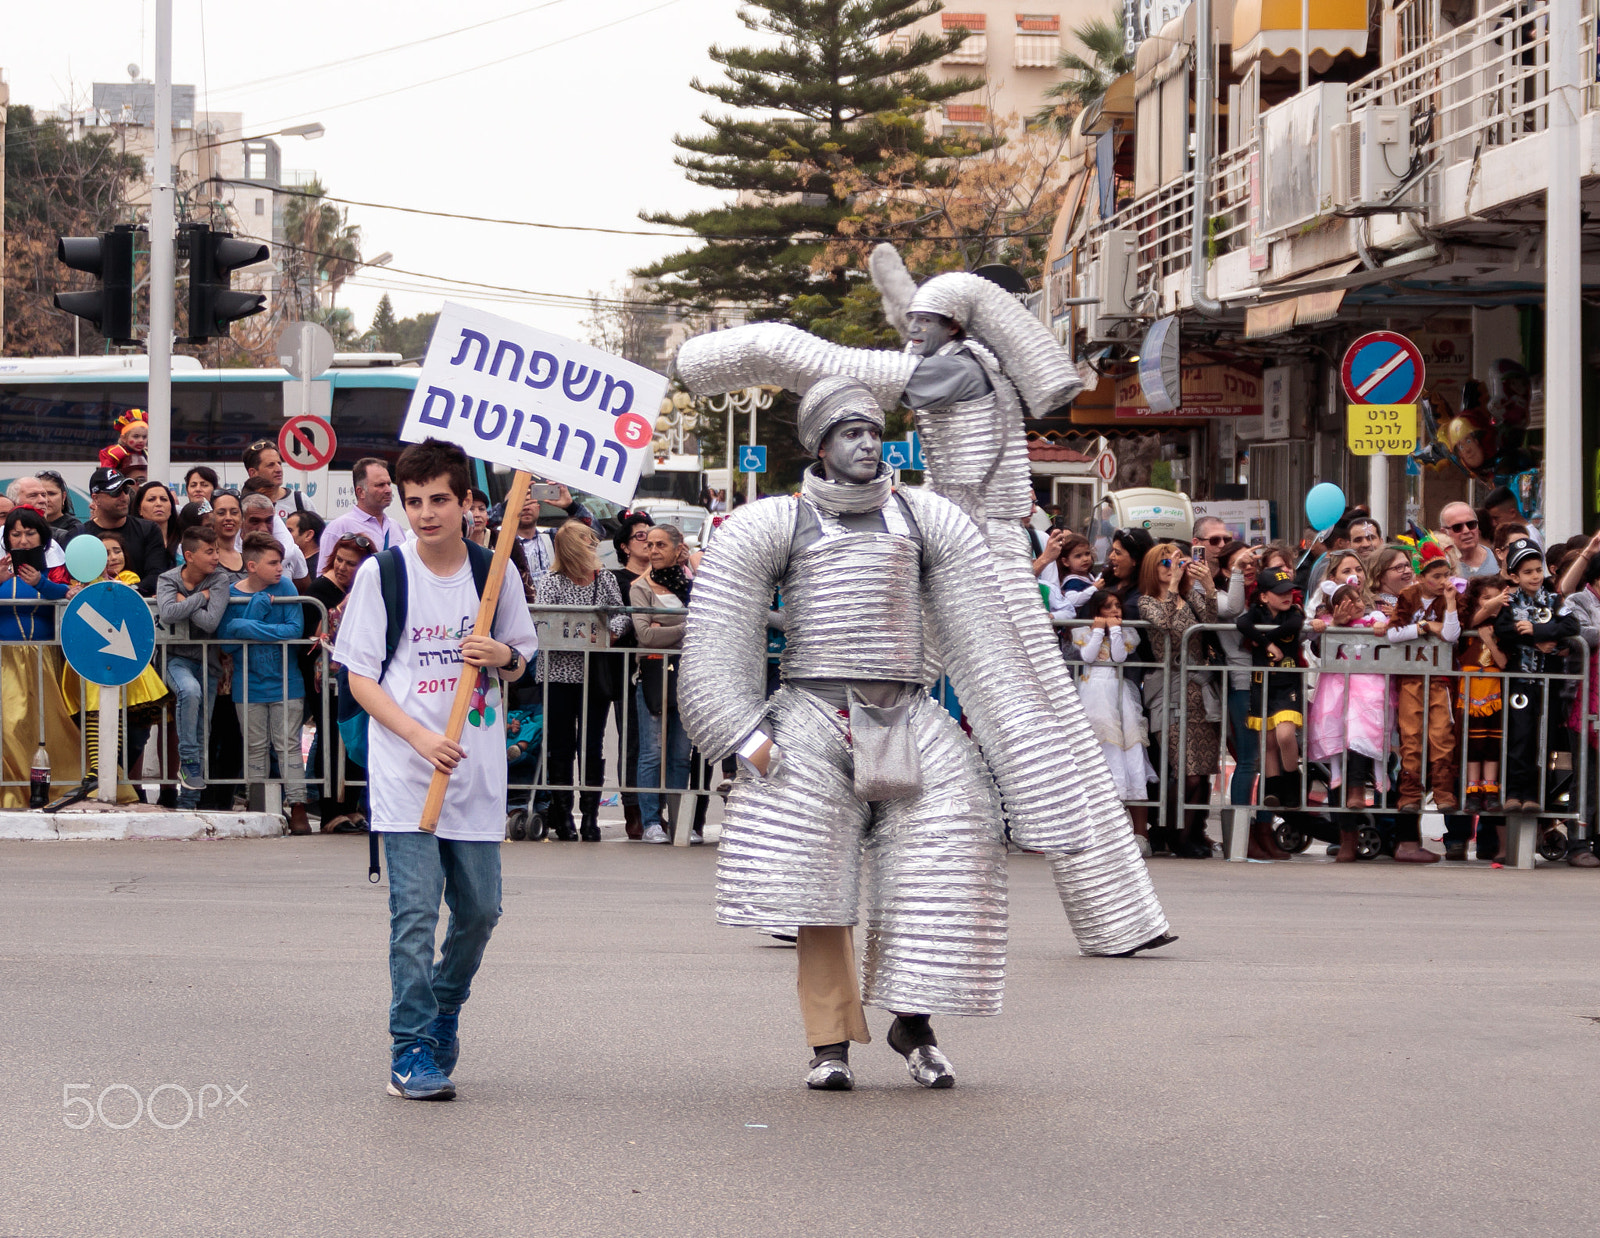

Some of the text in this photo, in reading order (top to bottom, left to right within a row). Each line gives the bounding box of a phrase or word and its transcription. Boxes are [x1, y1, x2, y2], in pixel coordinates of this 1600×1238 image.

[450, 327, 635, 417] משפחת
[1368, 410, 1399, 421] פרט
[418, 385, 628, 484] הרובוטים
[625, 421, 642, 440] 5
[1365, 422, 1402, 434] לרכב
[1354, 439, 1413, 449] משטרה
[417, 677, 458, 694] 2017
